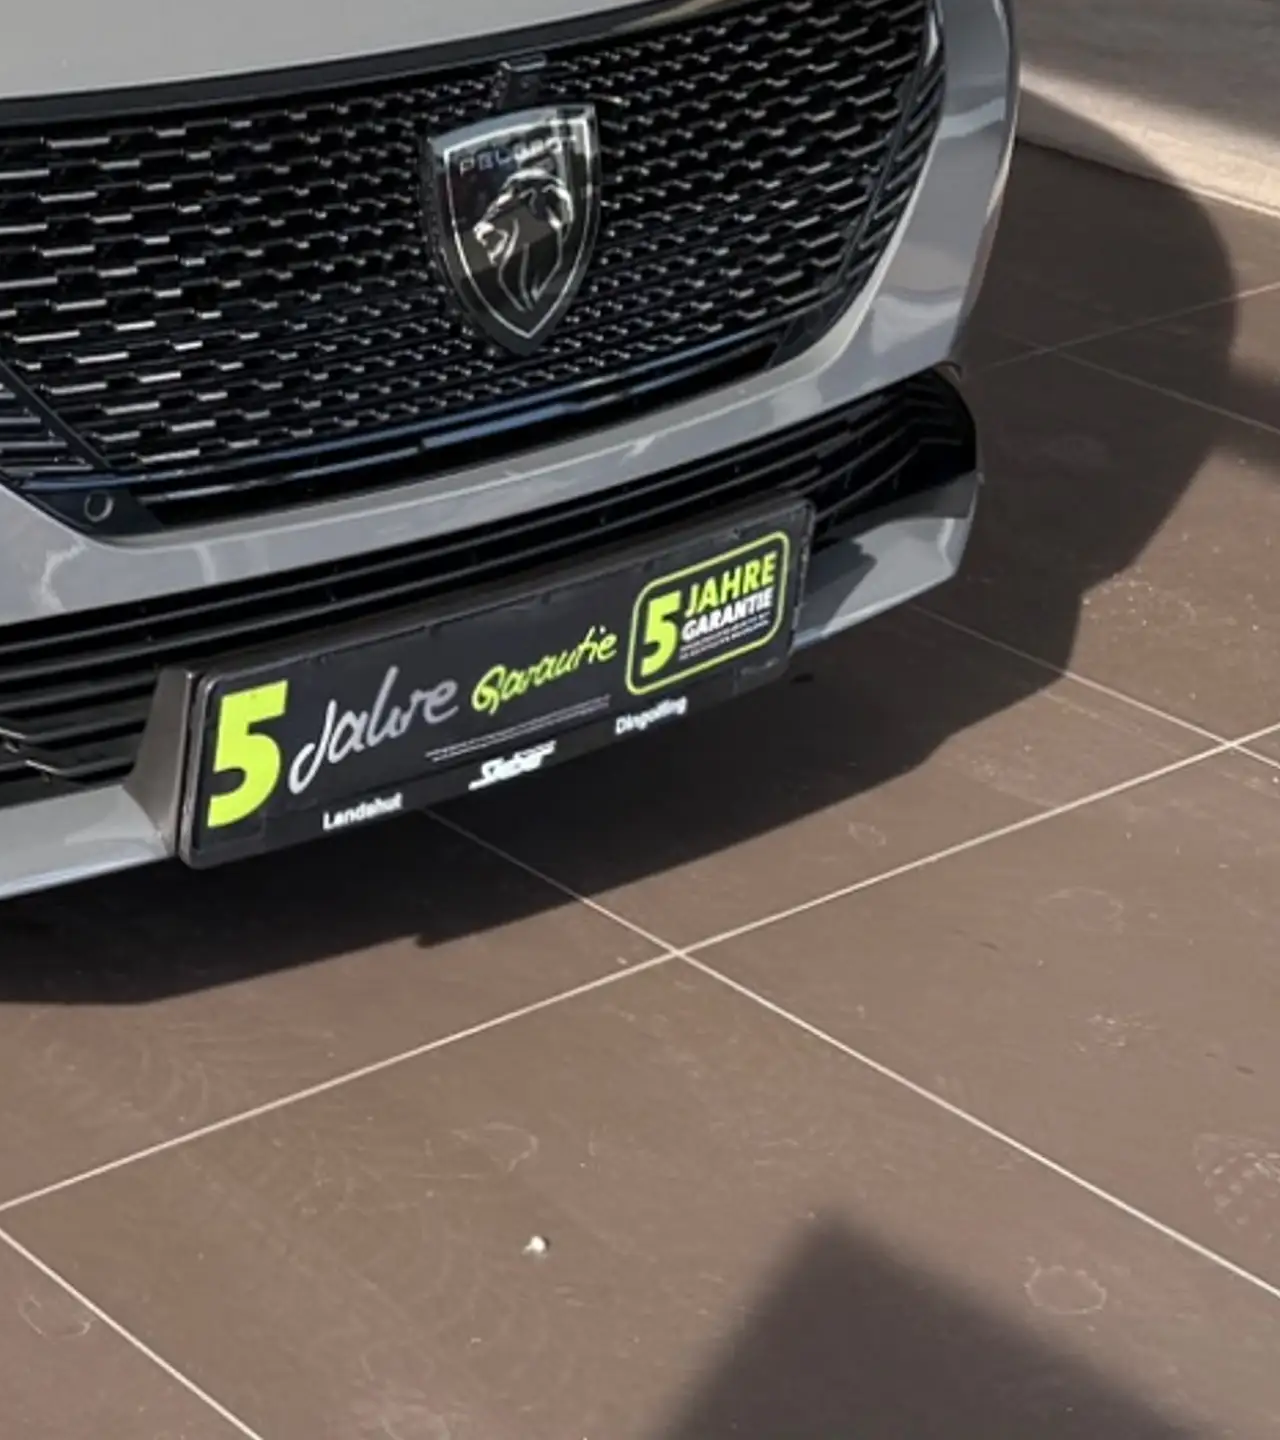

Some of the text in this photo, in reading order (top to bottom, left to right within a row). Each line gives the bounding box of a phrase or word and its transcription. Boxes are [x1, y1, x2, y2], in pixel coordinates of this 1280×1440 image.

[641, 590, 682, 678] 5
[684, 549, 778, 619] JAHRE
[681, 586, 774, 642] GARANTIE
[207, 679, 288, 828] 5
[287, 665, 459, 795] Jahre
[471, 624, 618, 717] Garantie
[322, 792, 404, 831] Landshut
